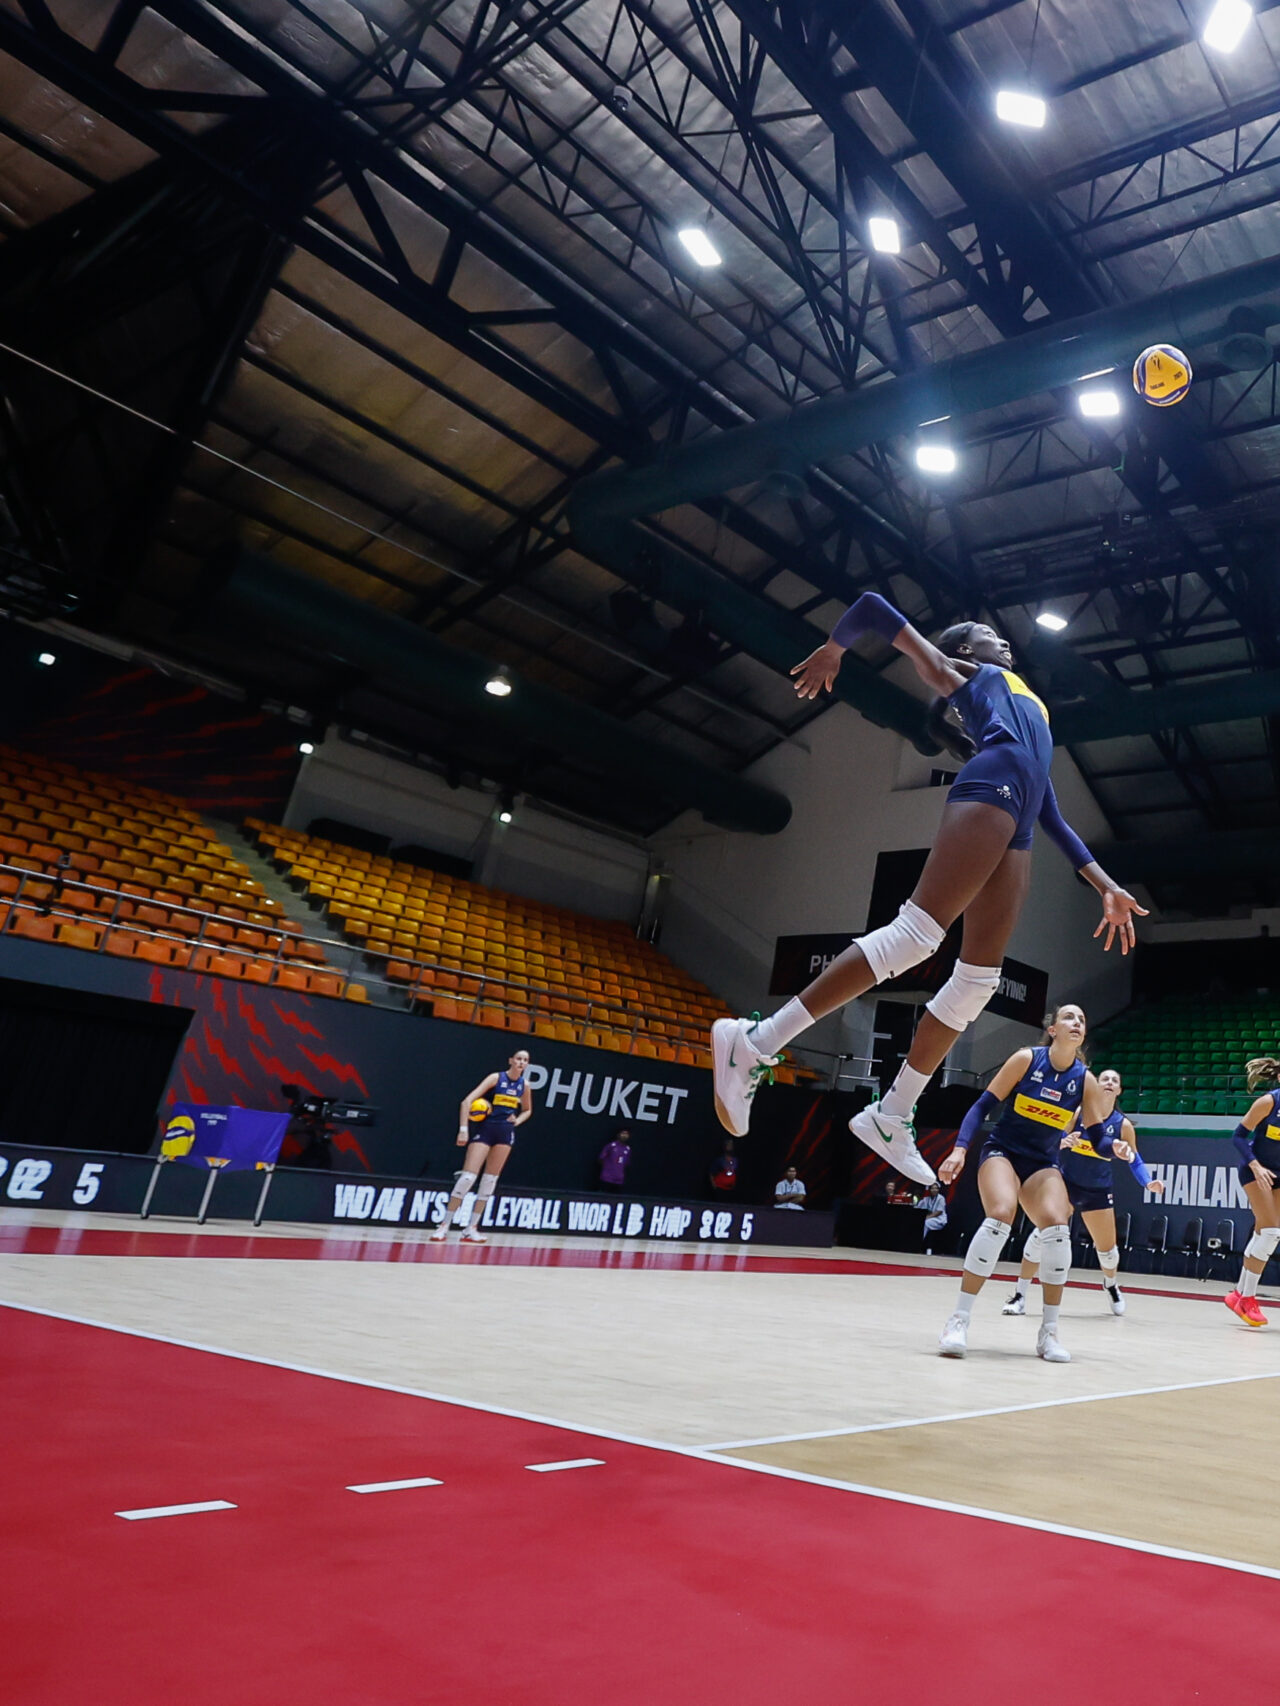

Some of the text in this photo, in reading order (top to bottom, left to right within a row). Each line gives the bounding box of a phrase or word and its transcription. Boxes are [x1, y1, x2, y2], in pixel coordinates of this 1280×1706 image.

[522, 1064, 689, 1124] PHUKET
[1024, 1104, 1062, 1121] DHL
[1143, 1163, 1252, 1210] THAILAN
